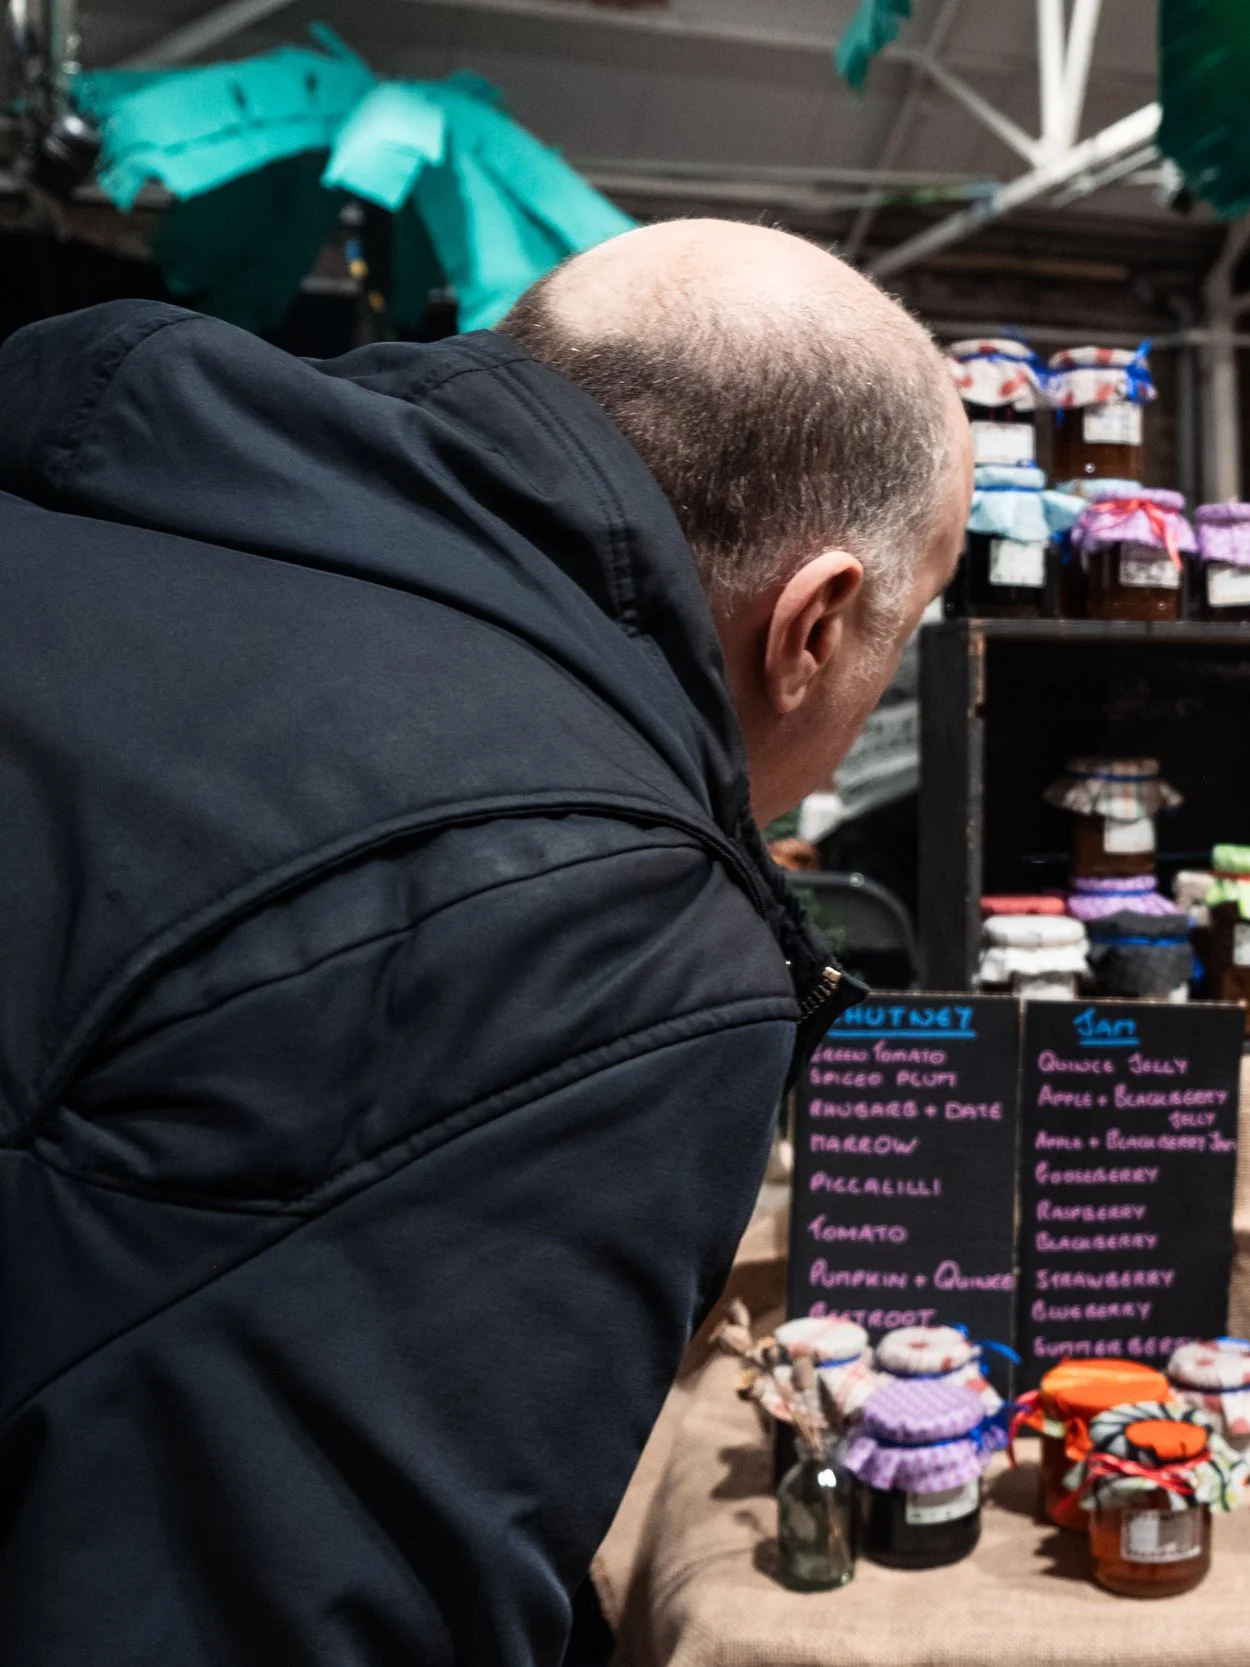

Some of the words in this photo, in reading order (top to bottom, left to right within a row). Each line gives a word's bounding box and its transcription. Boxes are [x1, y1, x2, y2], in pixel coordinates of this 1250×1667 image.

[834, 1005, 975, 1029] HUTNEY
[872, 1039, 948, 1065] TOMATO
[1037, 1049, 1115, 1074] QUINCE
[1127, 1051, 1189, 1075] JELLY
[809, 1067, 884, 1088] SPICED
[895, 1069, 958, 1088] PLUM
[1037, 1083, 1093, 1108] APPLE
[1112, 1082, 1229, 1109] BLACKBERRY
[809, 1098, 918, 1121] RHUBARB
[944, 1101, 1003, 1121] DATE
[1168, 1110, 1217, 1130] JELLY
[809, 1132, 920, 1155] MARROW
[1035, 1128, 1084, 1150] APPLE
[1104, 1127, 1206, 1152] BLACKBERRY
[809, 1170, 944, 1197] PICCALILLI
[1034, 1159, 1161, 1185] GOOSEBERRY
[1035, 1198, 1148, 1222] RASPBERRY
[807, 1213, 909, 1244] TOMATO
[1035, 1230, 1159, 1252] BLACKBERRY
[809, 1256, 909, 1289] PUMPKIN
[933, 1259, 1016, 1291] QUINCE
[1035, 1268, 1176, 1291] STRAWBERRY
[1031, 1298, 1152, 1321] BLUEBERRY
[1033, 1335, 1124, 1358] SUMMER
